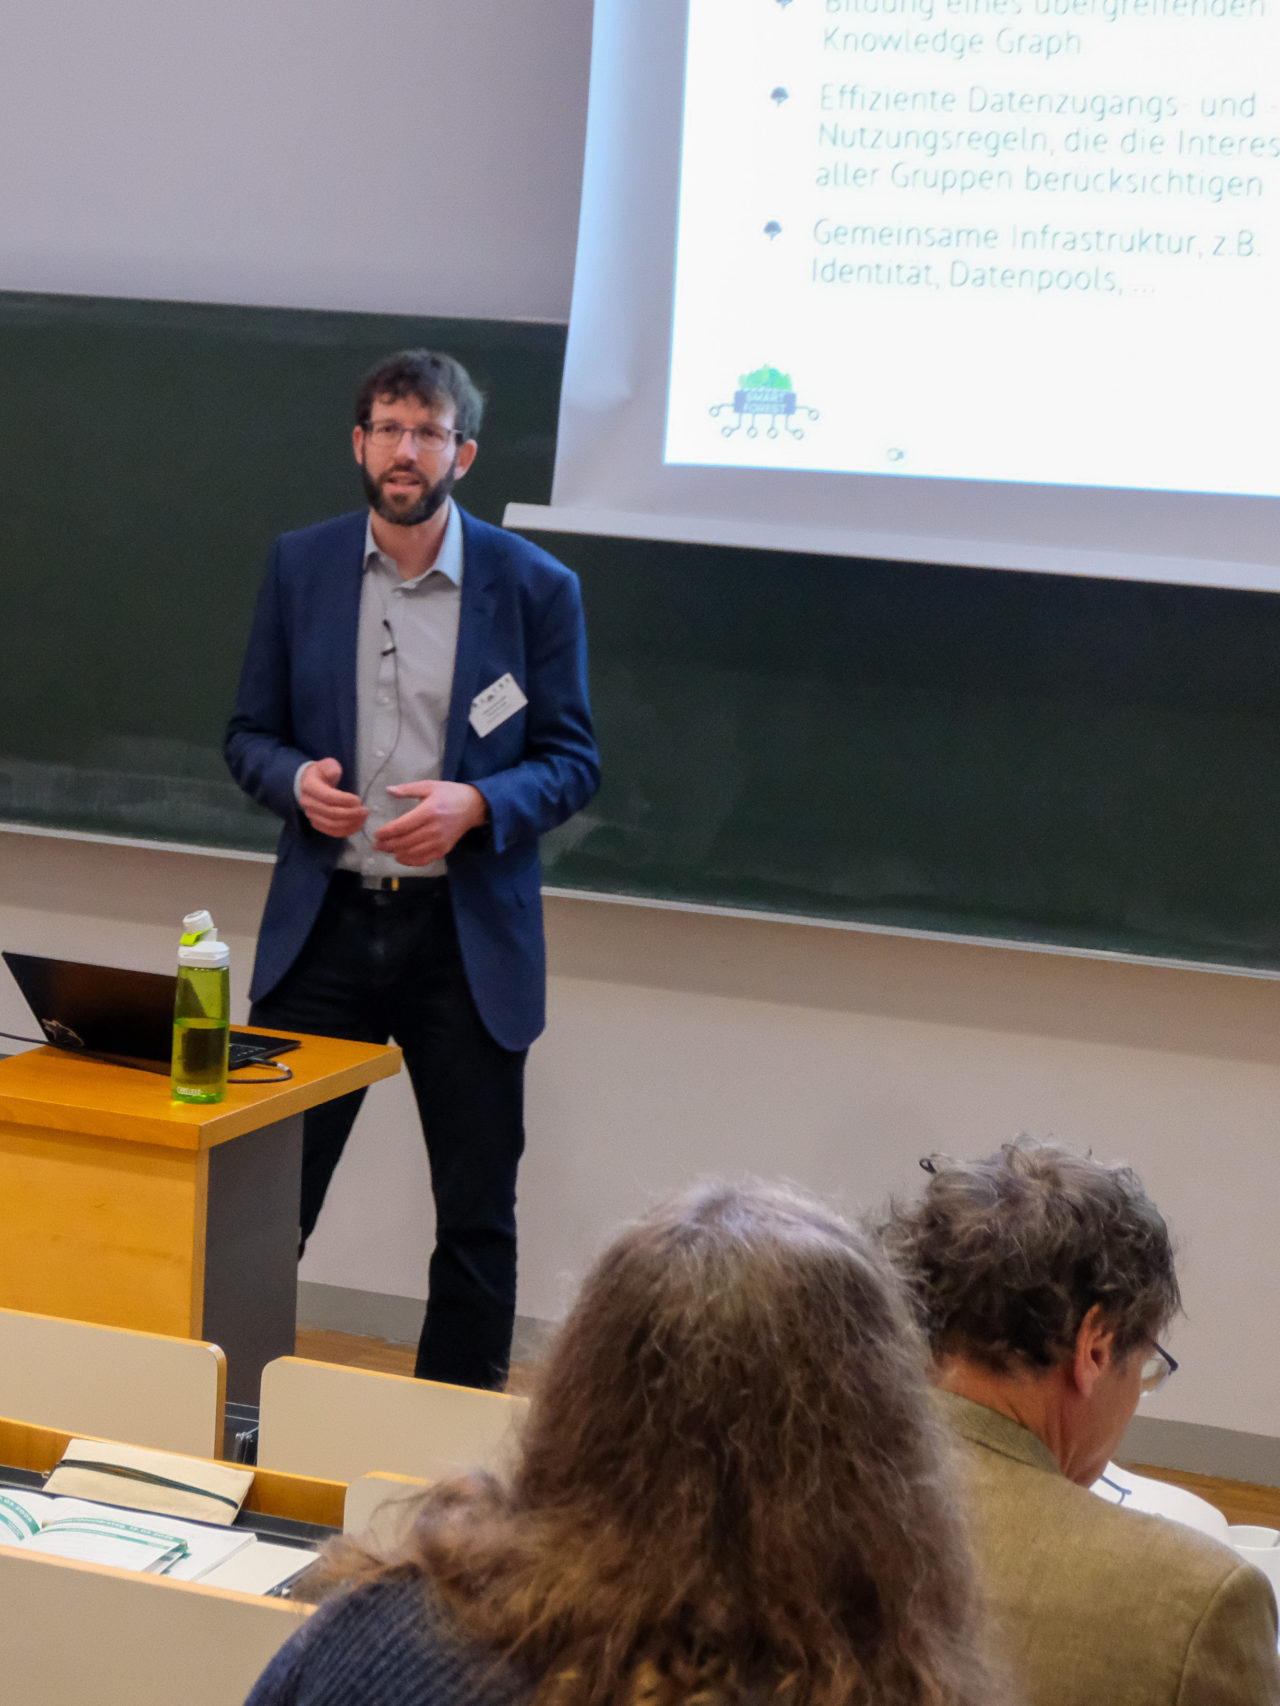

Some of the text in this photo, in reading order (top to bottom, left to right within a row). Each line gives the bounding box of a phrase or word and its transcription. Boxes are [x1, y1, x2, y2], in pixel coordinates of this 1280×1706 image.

[823, 26, 1082, 60] Knowledge Graph
[821, 83, 957, 112] Effiziente
[1200, 91, 1257, 118] und
[818, 122, 1054, 158] Nutzungsregeln,
[1064, 127, 1109, 154] die
[1120, 128, 1165, 155] die
[816, 162, 880, 188] aller
[890, 161, 1013, 196] Gruppen
[813, 217, 999, 249] Gemeinsame
[1012, 223, 1203, 260] Infrastruktur,
[949, 258, 1123, 297] Datenpools,
